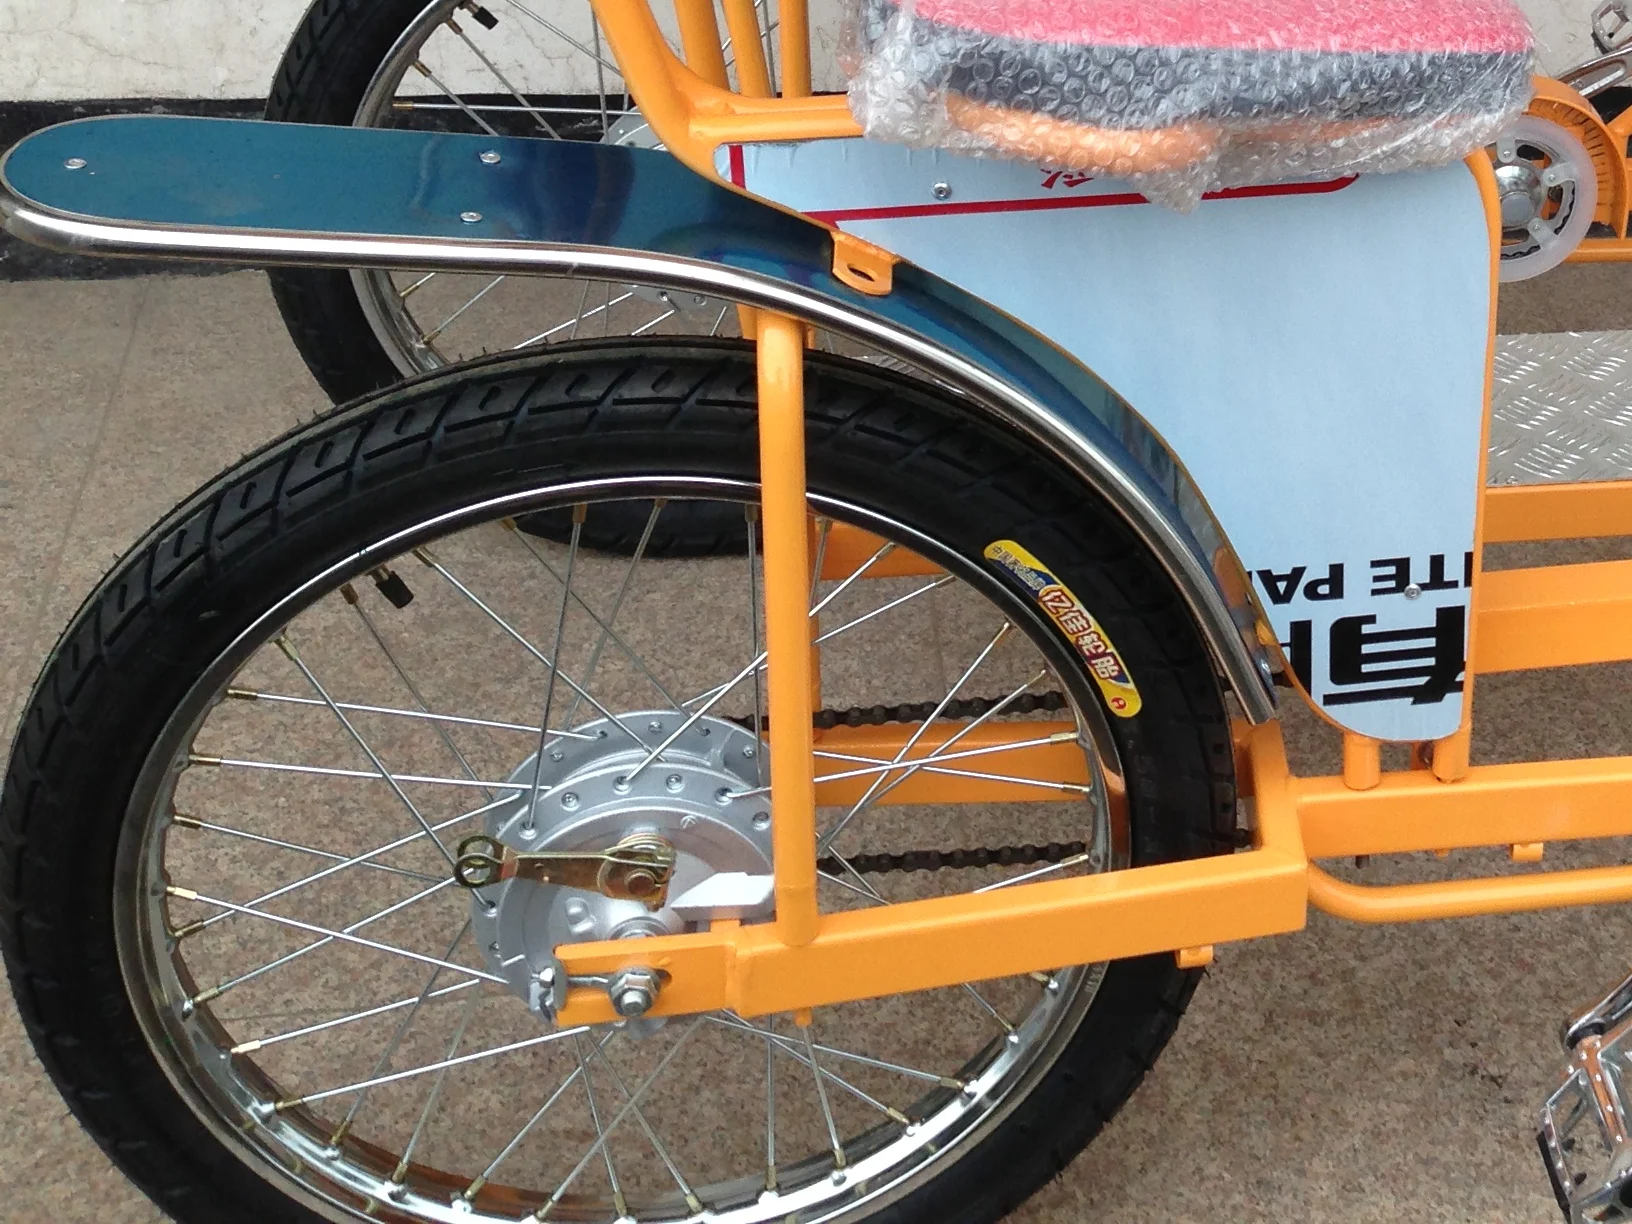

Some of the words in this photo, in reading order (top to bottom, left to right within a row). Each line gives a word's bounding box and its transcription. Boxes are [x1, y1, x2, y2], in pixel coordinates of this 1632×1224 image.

[1248, 563, 1344, 604] PA
[1039, 588, 1122, 680] 亿佳轮胎
